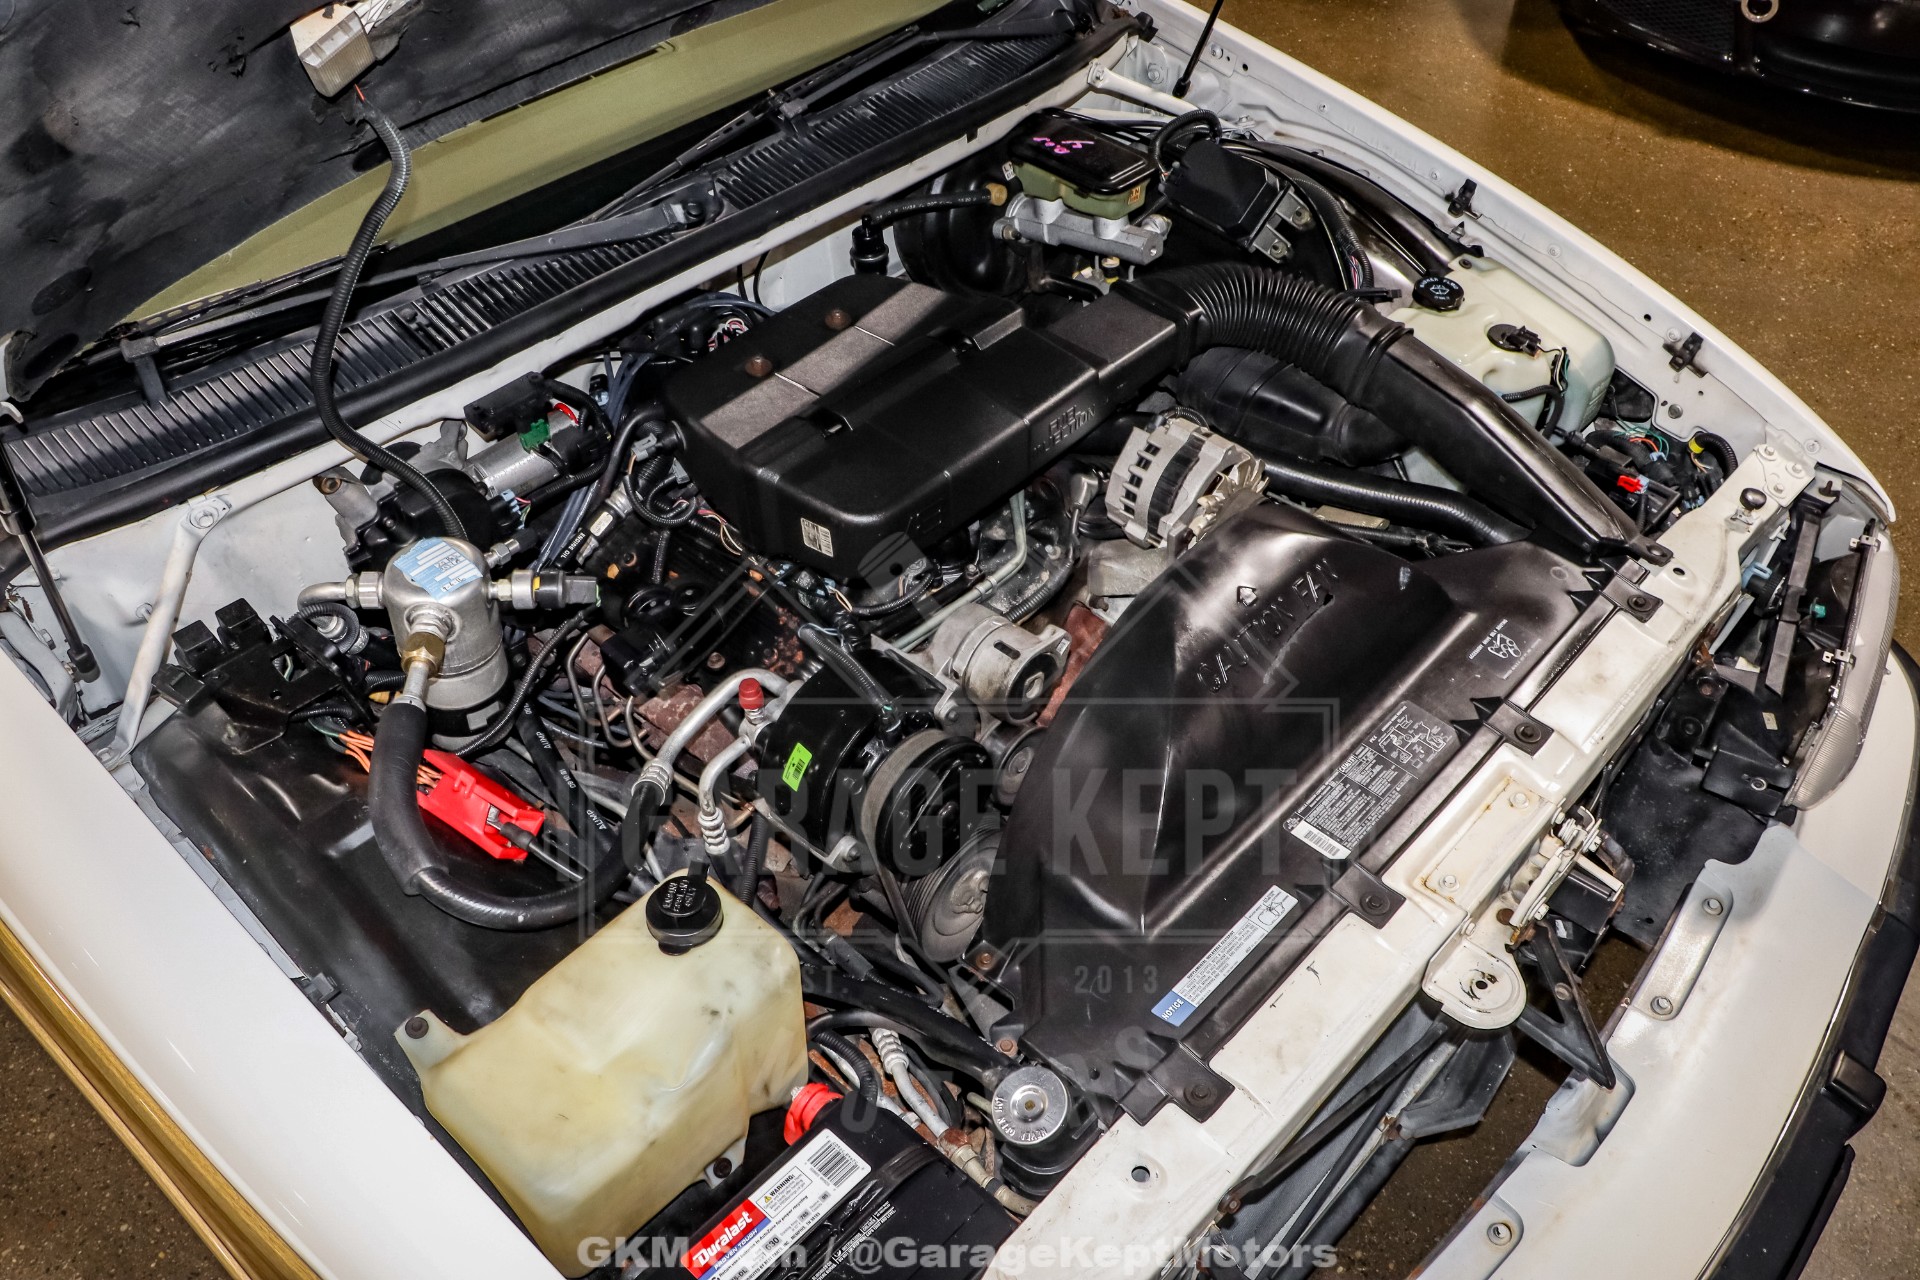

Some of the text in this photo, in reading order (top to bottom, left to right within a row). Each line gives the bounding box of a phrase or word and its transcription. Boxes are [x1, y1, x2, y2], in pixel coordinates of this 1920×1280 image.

[560, 532, 586, 559] ENGINE OIL
[1197, 558, 1338, 695] CAUTION FAN
[1161, 997, 1185, 1020] NOTICE
[994, 1096, 1048, 1142] NEVER OPEN HOT
[769, 1174, 795, 1197] WARNING!
[692, 1211, 753, 1266] Duralast
[714, 1246, 738, 1270] PROVEN
[738, 1228, 758, 1249] TOUGH
[765, 1237, 780, 1251] 630
